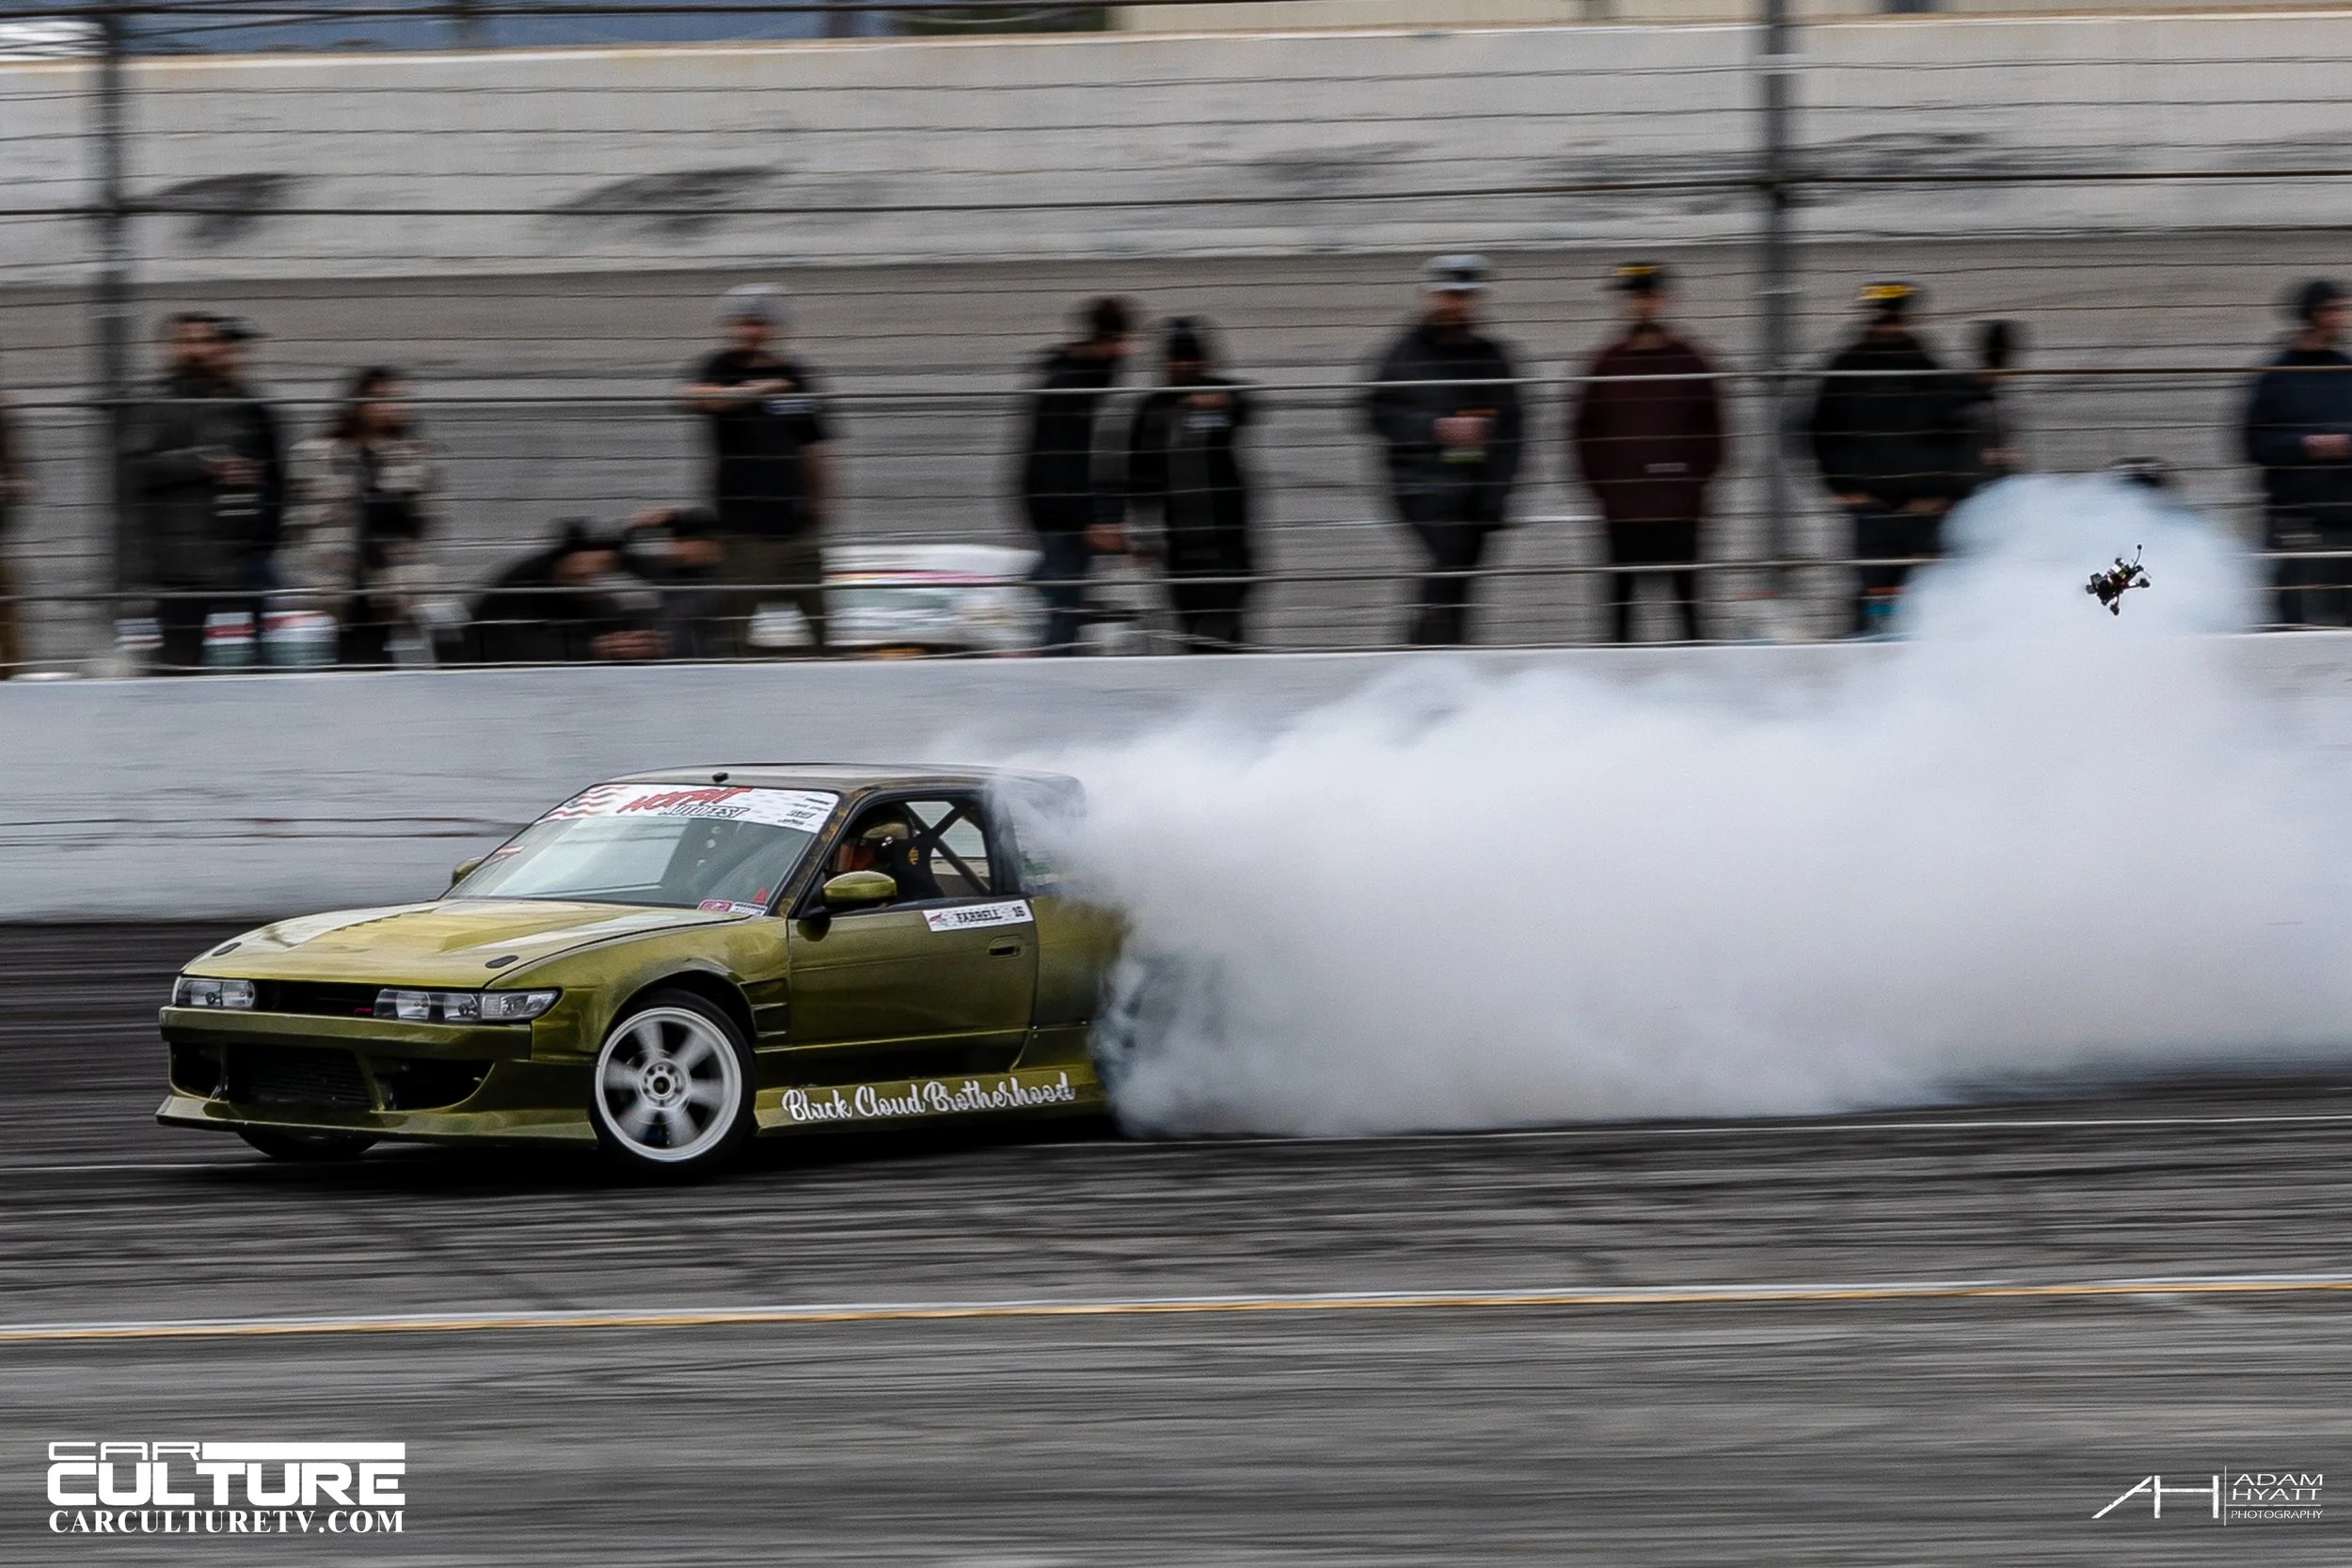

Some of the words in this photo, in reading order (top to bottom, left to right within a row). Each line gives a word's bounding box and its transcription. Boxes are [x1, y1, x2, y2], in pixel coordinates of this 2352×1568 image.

[658, 803, 751, 818] AUTOFEST
[955, 910, 1003, 924] FARRELL
[782, 1089, 852, 1121] Black
[854, 1084, 926, 1117] Cloud
[923, 1071, 1076, 1112] Brotherhood
